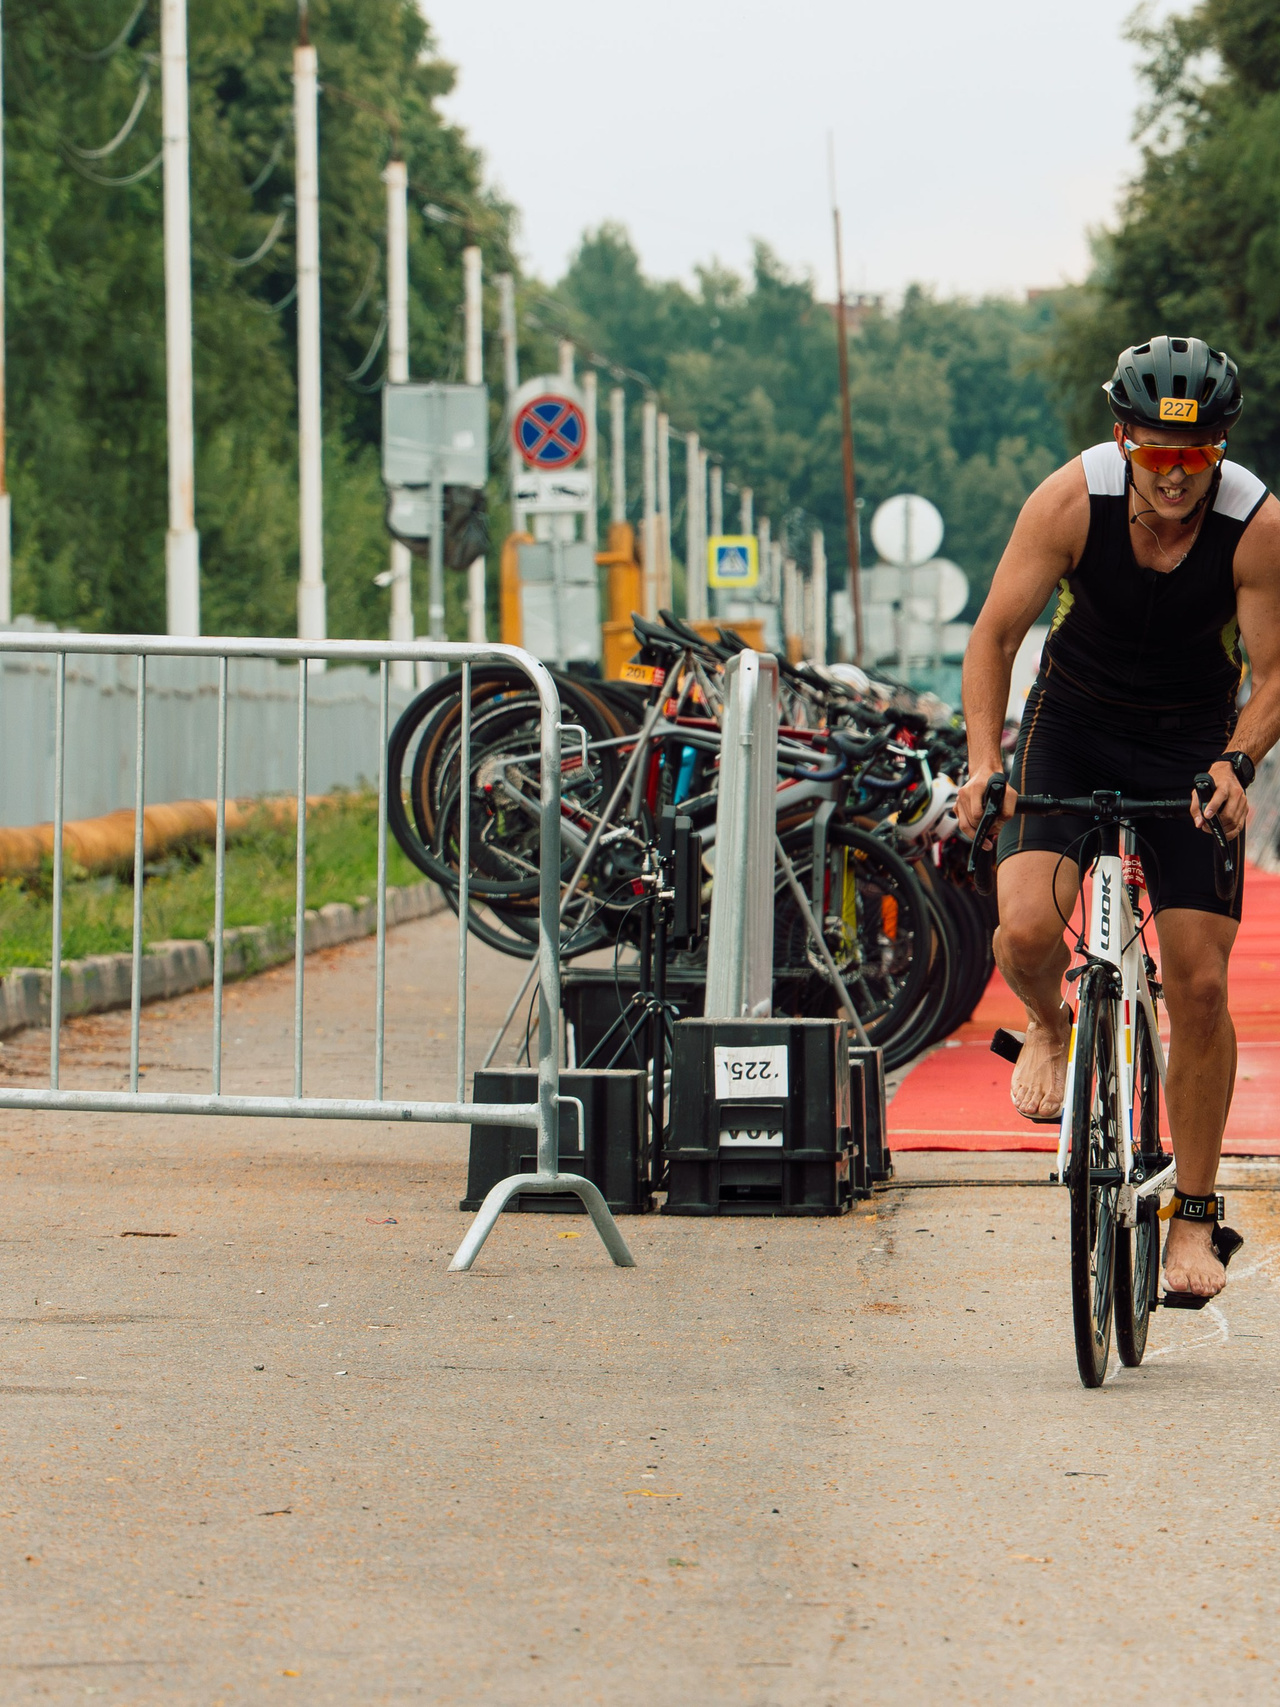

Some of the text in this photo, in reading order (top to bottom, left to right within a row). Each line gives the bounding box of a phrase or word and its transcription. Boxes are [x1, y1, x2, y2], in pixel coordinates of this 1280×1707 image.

[1163, 401, 1194, 417] 227
[626, 666, 646, 679] 201
[1101, 869, 1112, 951] LOOK
[731, 1061, 771, 1080] 225
[1188, 1204, 1202, 1214] LT
